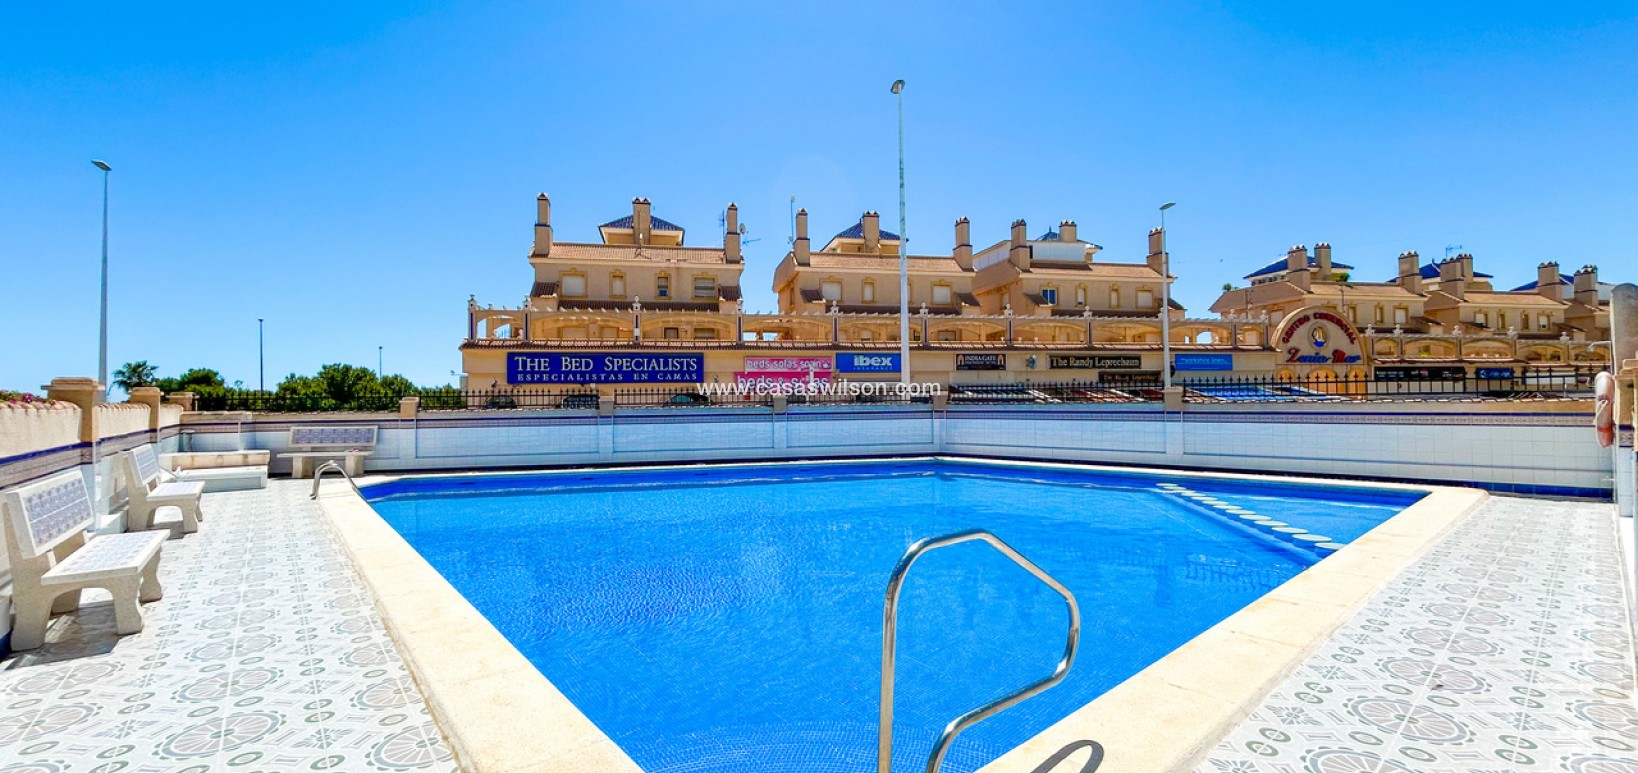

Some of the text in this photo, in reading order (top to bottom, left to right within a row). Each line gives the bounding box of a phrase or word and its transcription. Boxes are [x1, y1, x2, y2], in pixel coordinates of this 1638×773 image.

[1282, 314, 1311, 344] CENTRO
[514, 356, 697, 371] THE BED SPECIALISTS
[746, 359, 770, 369] beds
[853, 355, 892, 366] ibex
[1051, 357, 1140, 368] The Randy Leprechaun
[517, 373, 623, 381] ESPECIALISTAS
[657, 372, 697, 380] CAMAS
